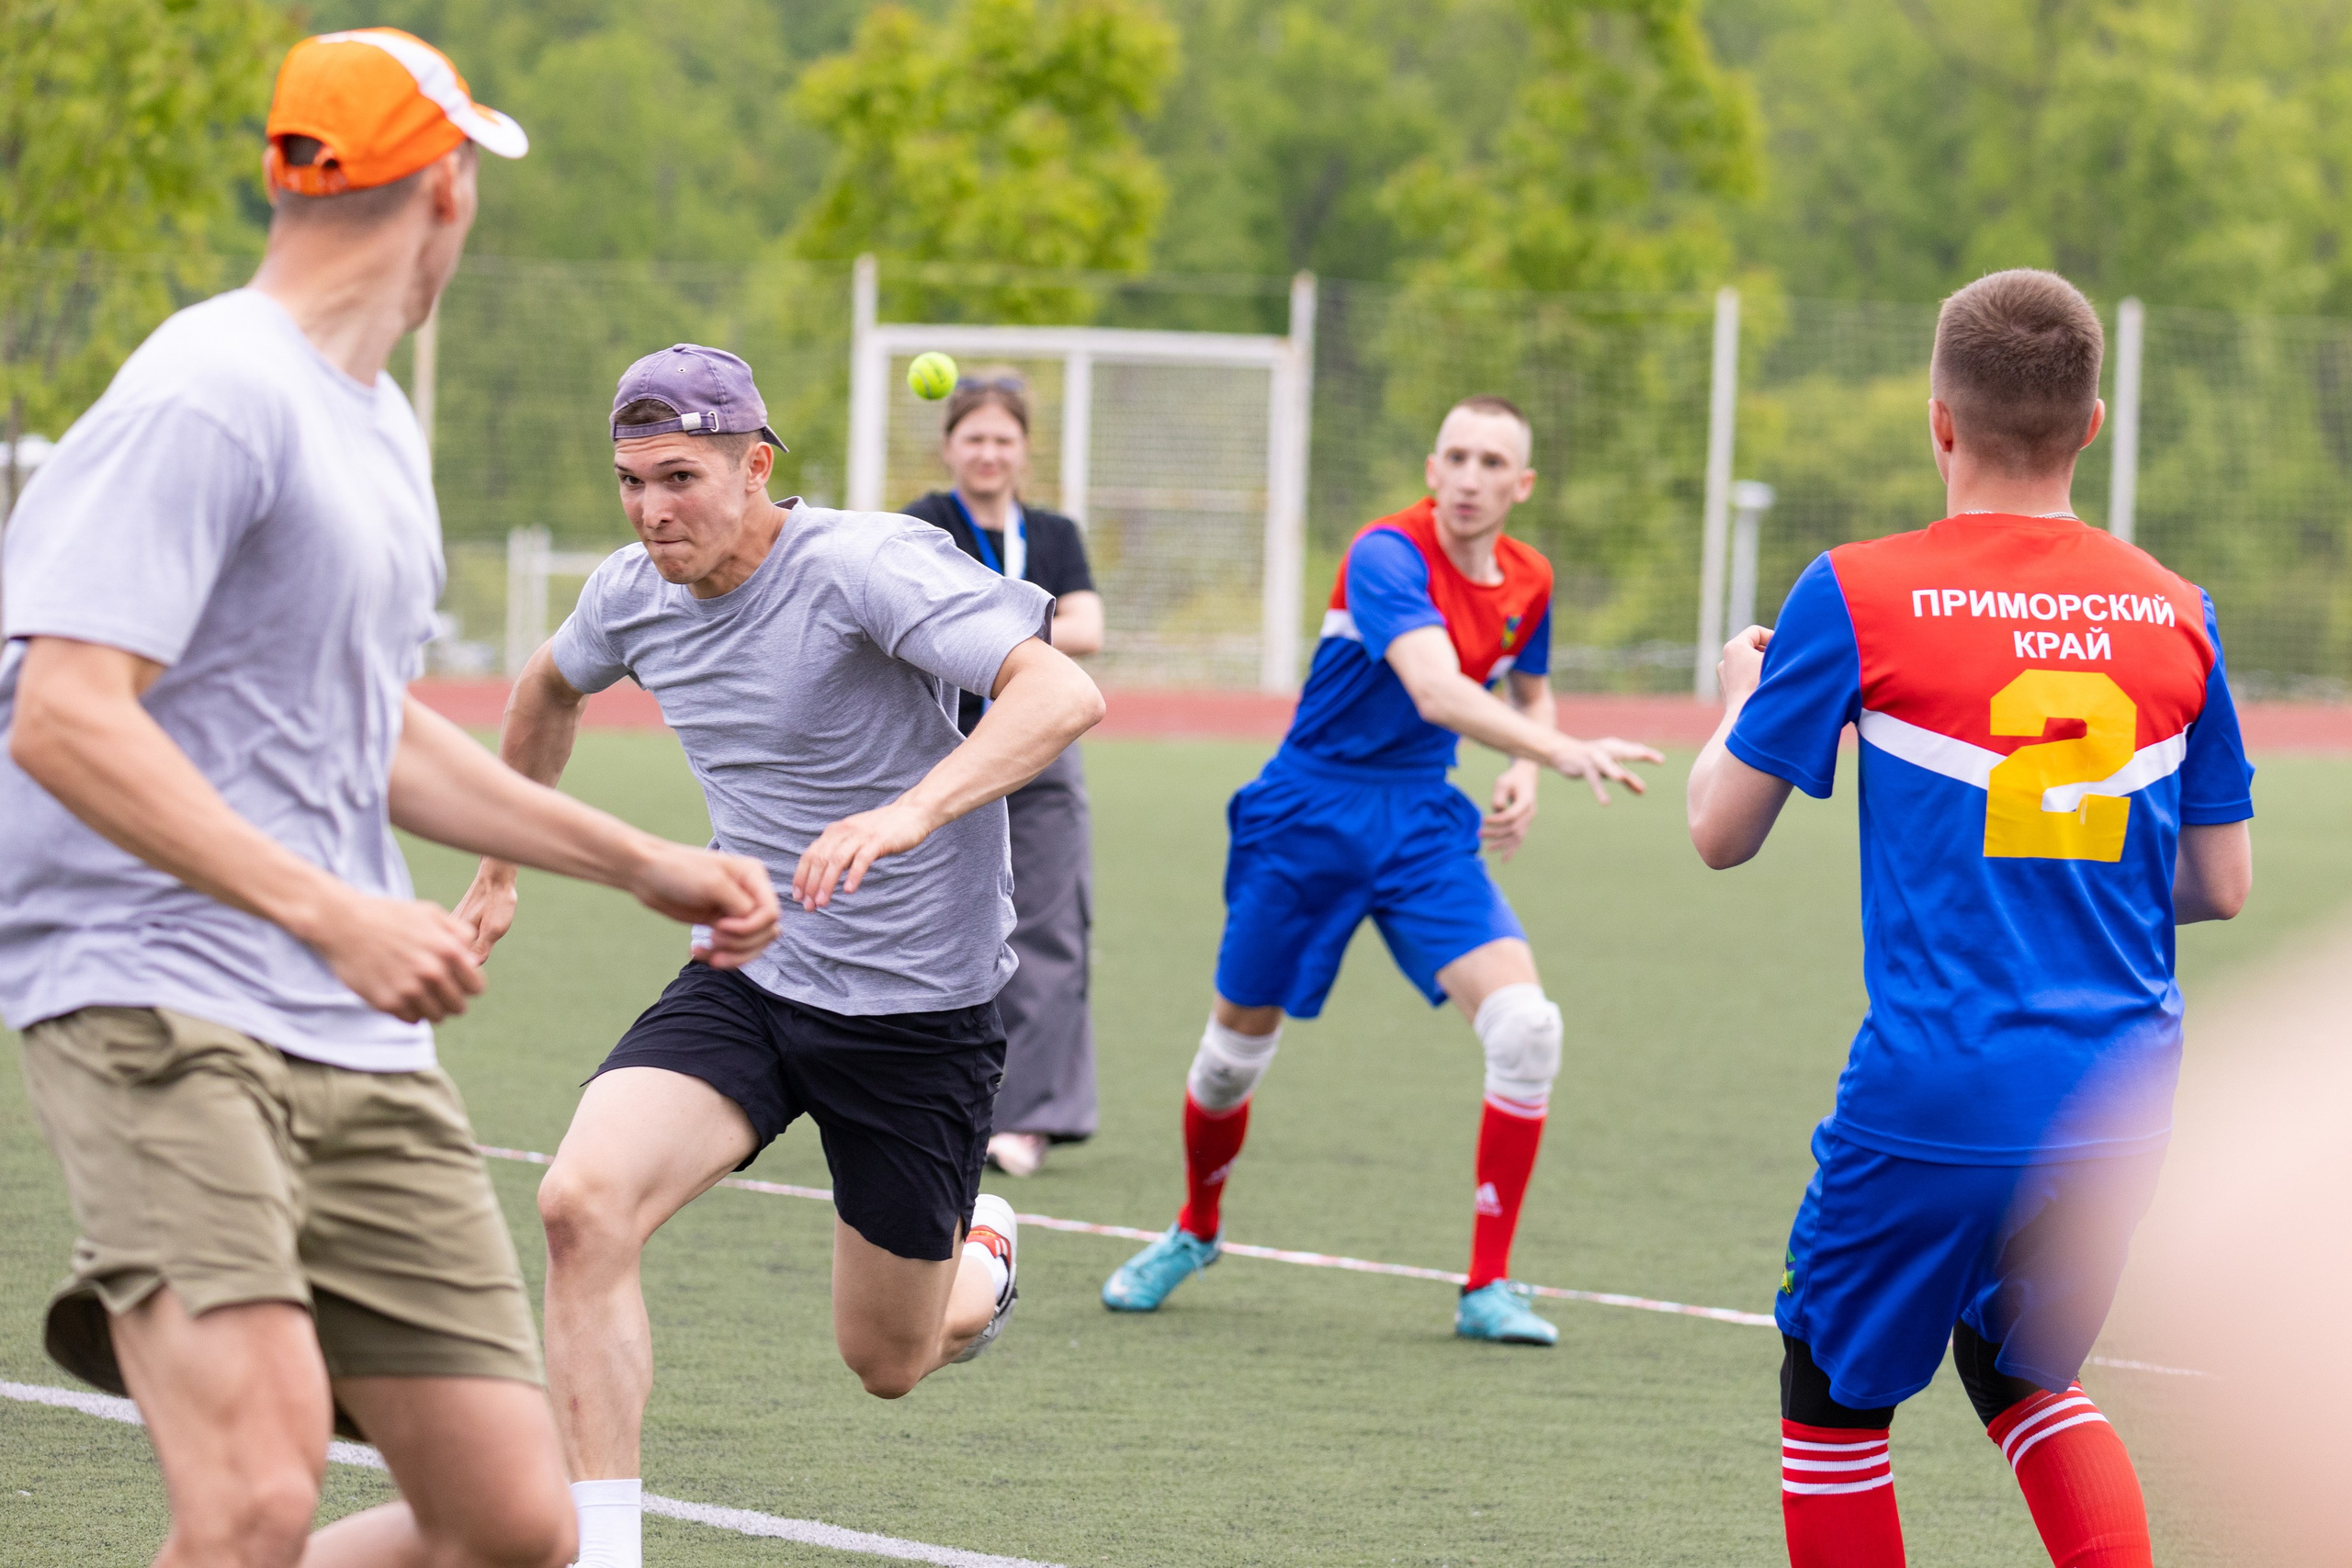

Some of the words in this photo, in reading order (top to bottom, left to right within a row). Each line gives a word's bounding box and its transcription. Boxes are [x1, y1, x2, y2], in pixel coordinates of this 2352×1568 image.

[1912, 589, 2176, 627] ПРИМОРСКИЙ
[2013, 626, 2111, 660] КРАЙ
[1983, 669, 2137, 862] 2
